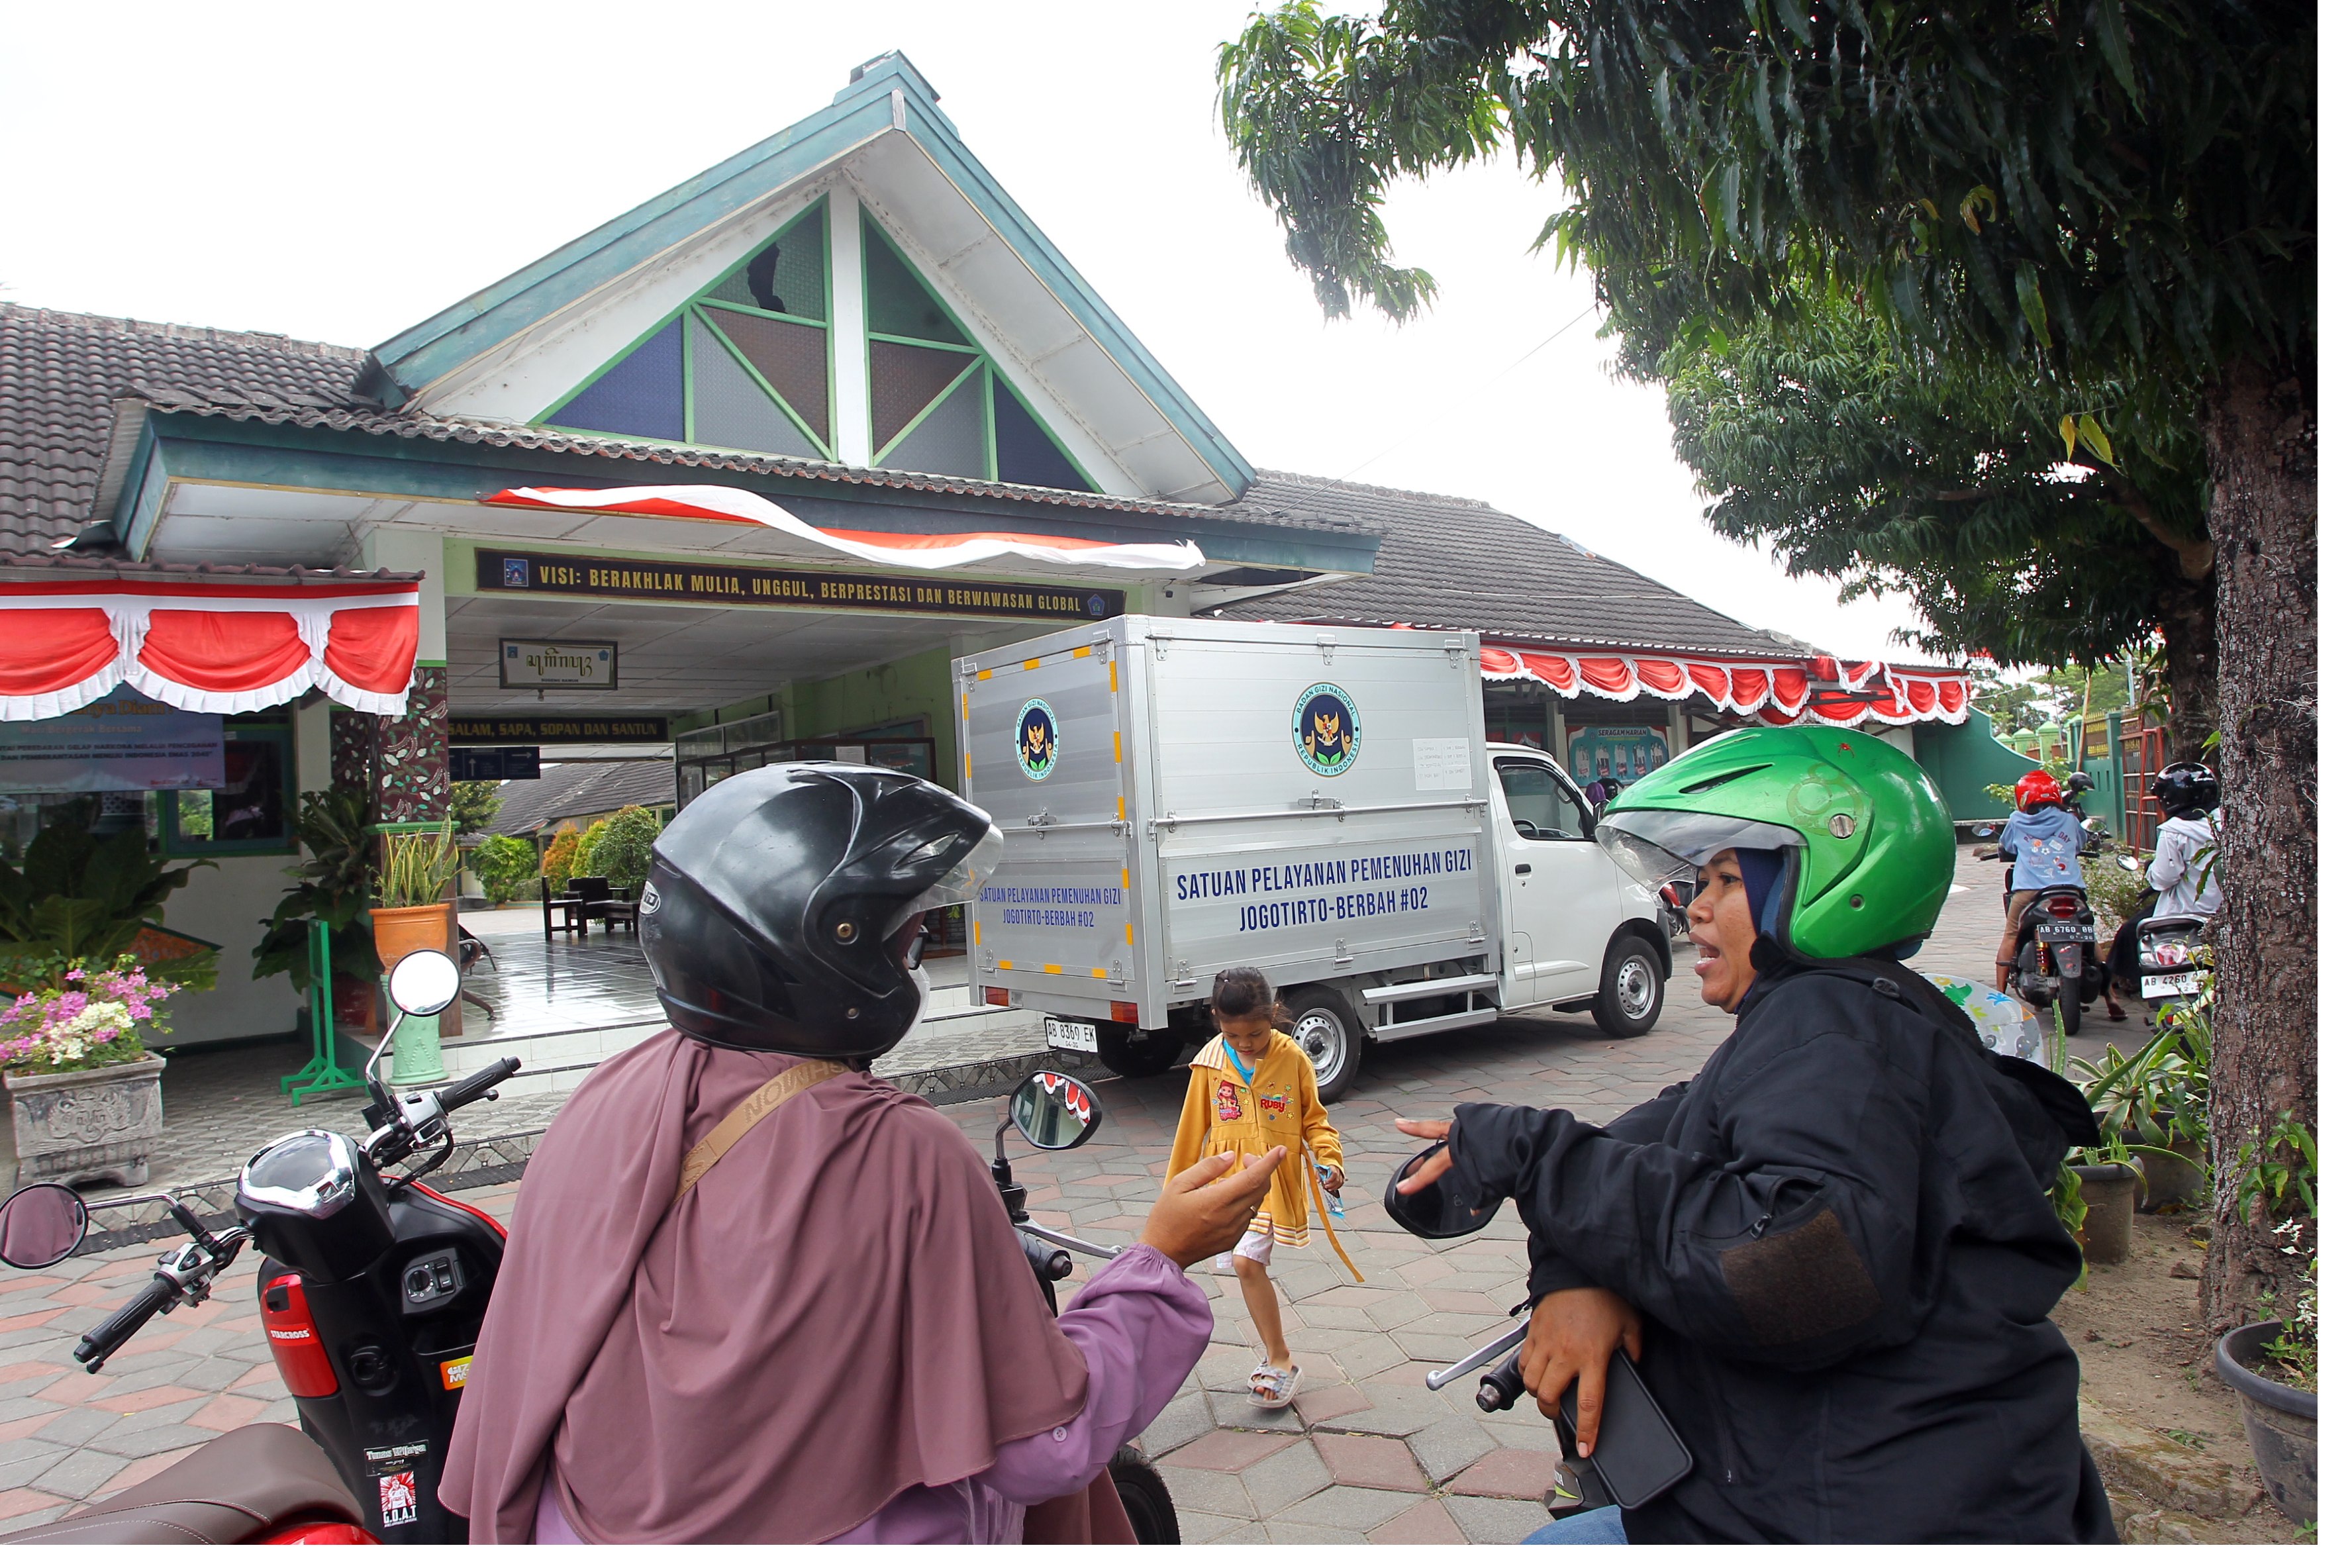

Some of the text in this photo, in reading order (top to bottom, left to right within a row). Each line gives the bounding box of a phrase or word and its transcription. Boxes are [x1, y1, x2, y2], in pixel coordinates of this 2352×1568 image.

[540, 566, 1081, 612] VISI: BERAKHLAK MULIA, UNGGUL, BERPRESTASI DAN BERWAWASAN GLOBAL
[1297, 689, 1314, 714] BADAN
[1329, 687, 1356, 717] NASIONAL
[1037, 701, 1055, 725] NASIONAL
[499, 724, 536, 738] SAPA,
[541, 723, 580, 735] SOPAN
[585, 723, 609, 735] DAN
[612, 723, 657, 735] SANTUN
[1038, 744, 1057, 778] INDONESIA
[1297, 737, 1359, 774] REPUBLIK INDONESIA
[2058, 831, 2071, 844] DAY
[1177, 849, 1471, 901] SATUAN PELAYANAN PEMENUHAN GIZI
[980, 887, 1121, 905] SATUAN PELAYANAN PEMENUHAN GIZI
[1003, 909, 1095, 927] JOGOTIRTO-BERBAH #02
[1240, 886, 1428, 932] JOGOTIRTO-BERBAH #02
[2144, 975, 2186, 986] AB 4260
[1048, 1023, 1095, 1042] AB 8369 EK
[270, 1330, 310, 1339] STARCROSS
[366, 1449, 392, 1460] Tunas
[383, 1504, 416, 1523] G.O.A.T
